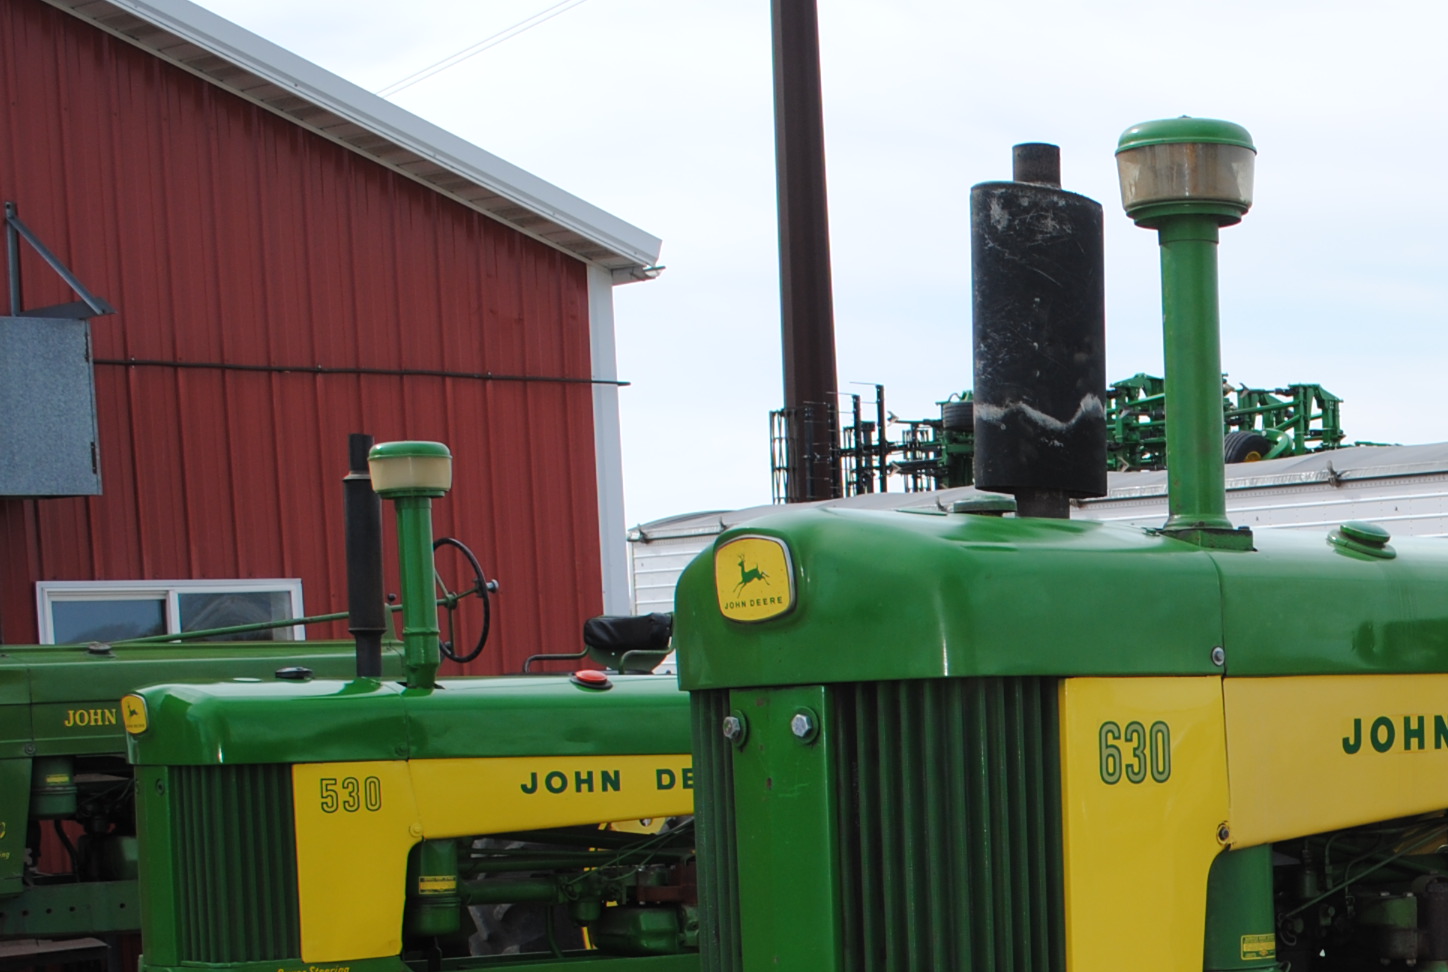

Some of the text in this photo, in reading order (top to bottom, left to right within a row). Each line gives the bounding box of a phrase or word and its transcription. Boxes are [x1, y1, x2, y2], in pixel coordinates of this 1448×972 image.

[724, 596, 783, 610] JOHN DEERE
[64, 708, 117, 727] JOHN
[1099, 720, 1171, 785] 630
[320, 776, 382, 814] 530
[520, 769, 621, 795] JOHN
